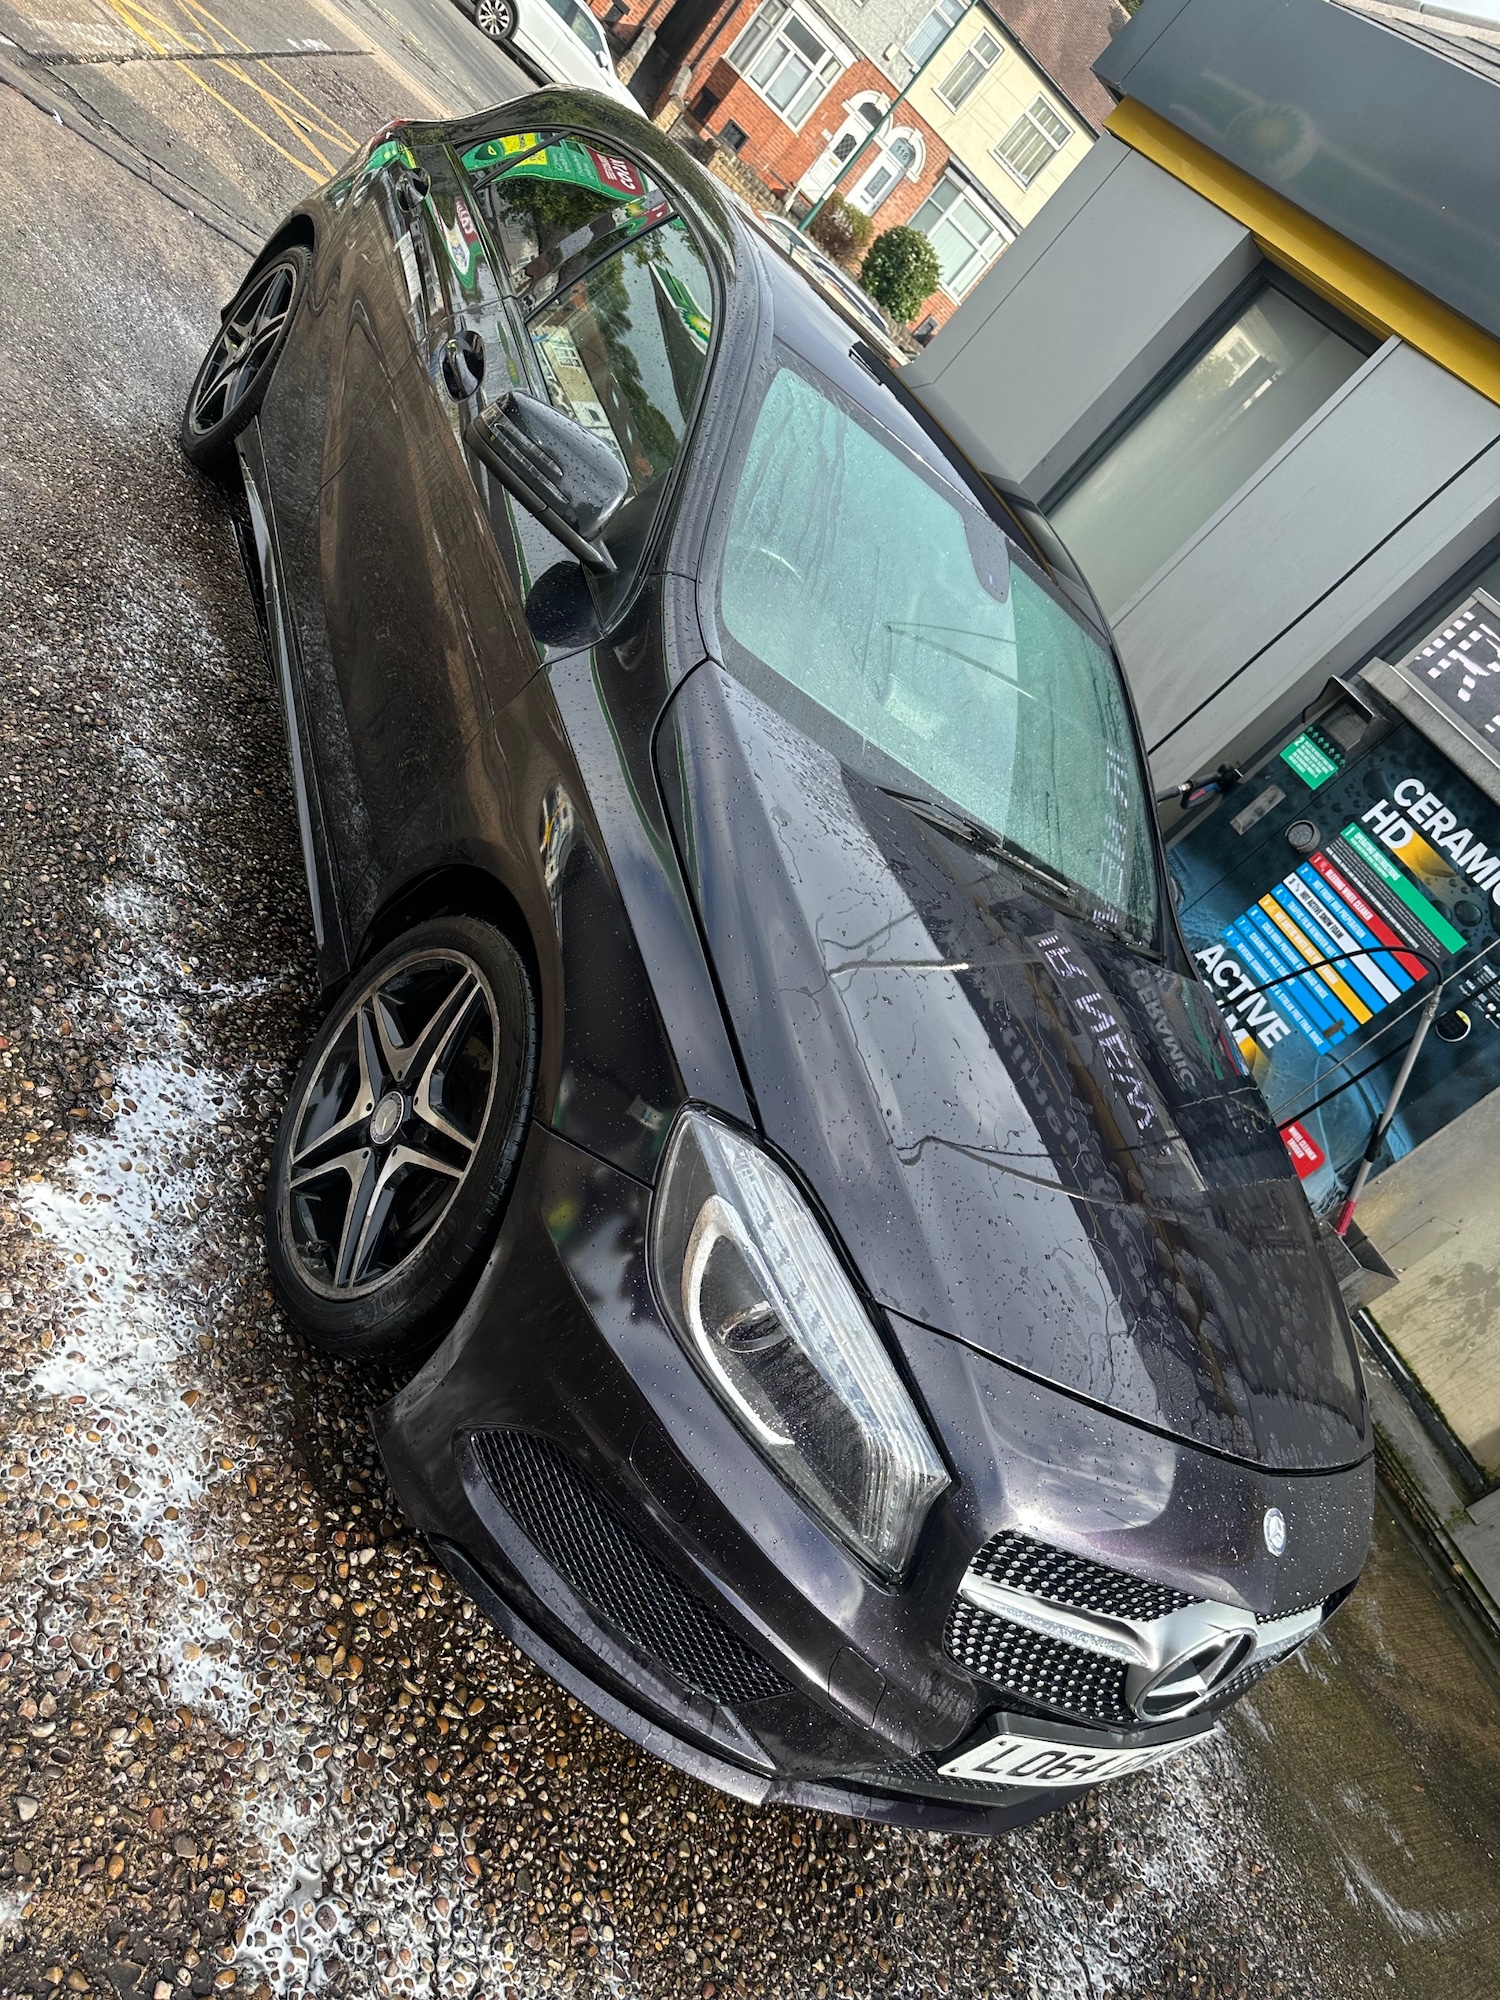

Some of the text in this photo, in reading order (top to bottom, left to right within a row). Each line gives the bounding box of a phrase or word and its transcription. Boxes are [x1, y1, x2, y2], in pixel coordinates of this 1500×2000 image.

[895, 145, 909, 161] 118
[1361, 799, 1415, 853] HD
[1306, 897, 1323, 915] ACTIVE
[1317, 911, 1333, 927] SNOW
[1327, 923, 1344, 939] FOAM
[1194, 942, 1290, 1048] ACTIVE
[1287, 1125, 1317, 1161] WHEEL CLEANER
